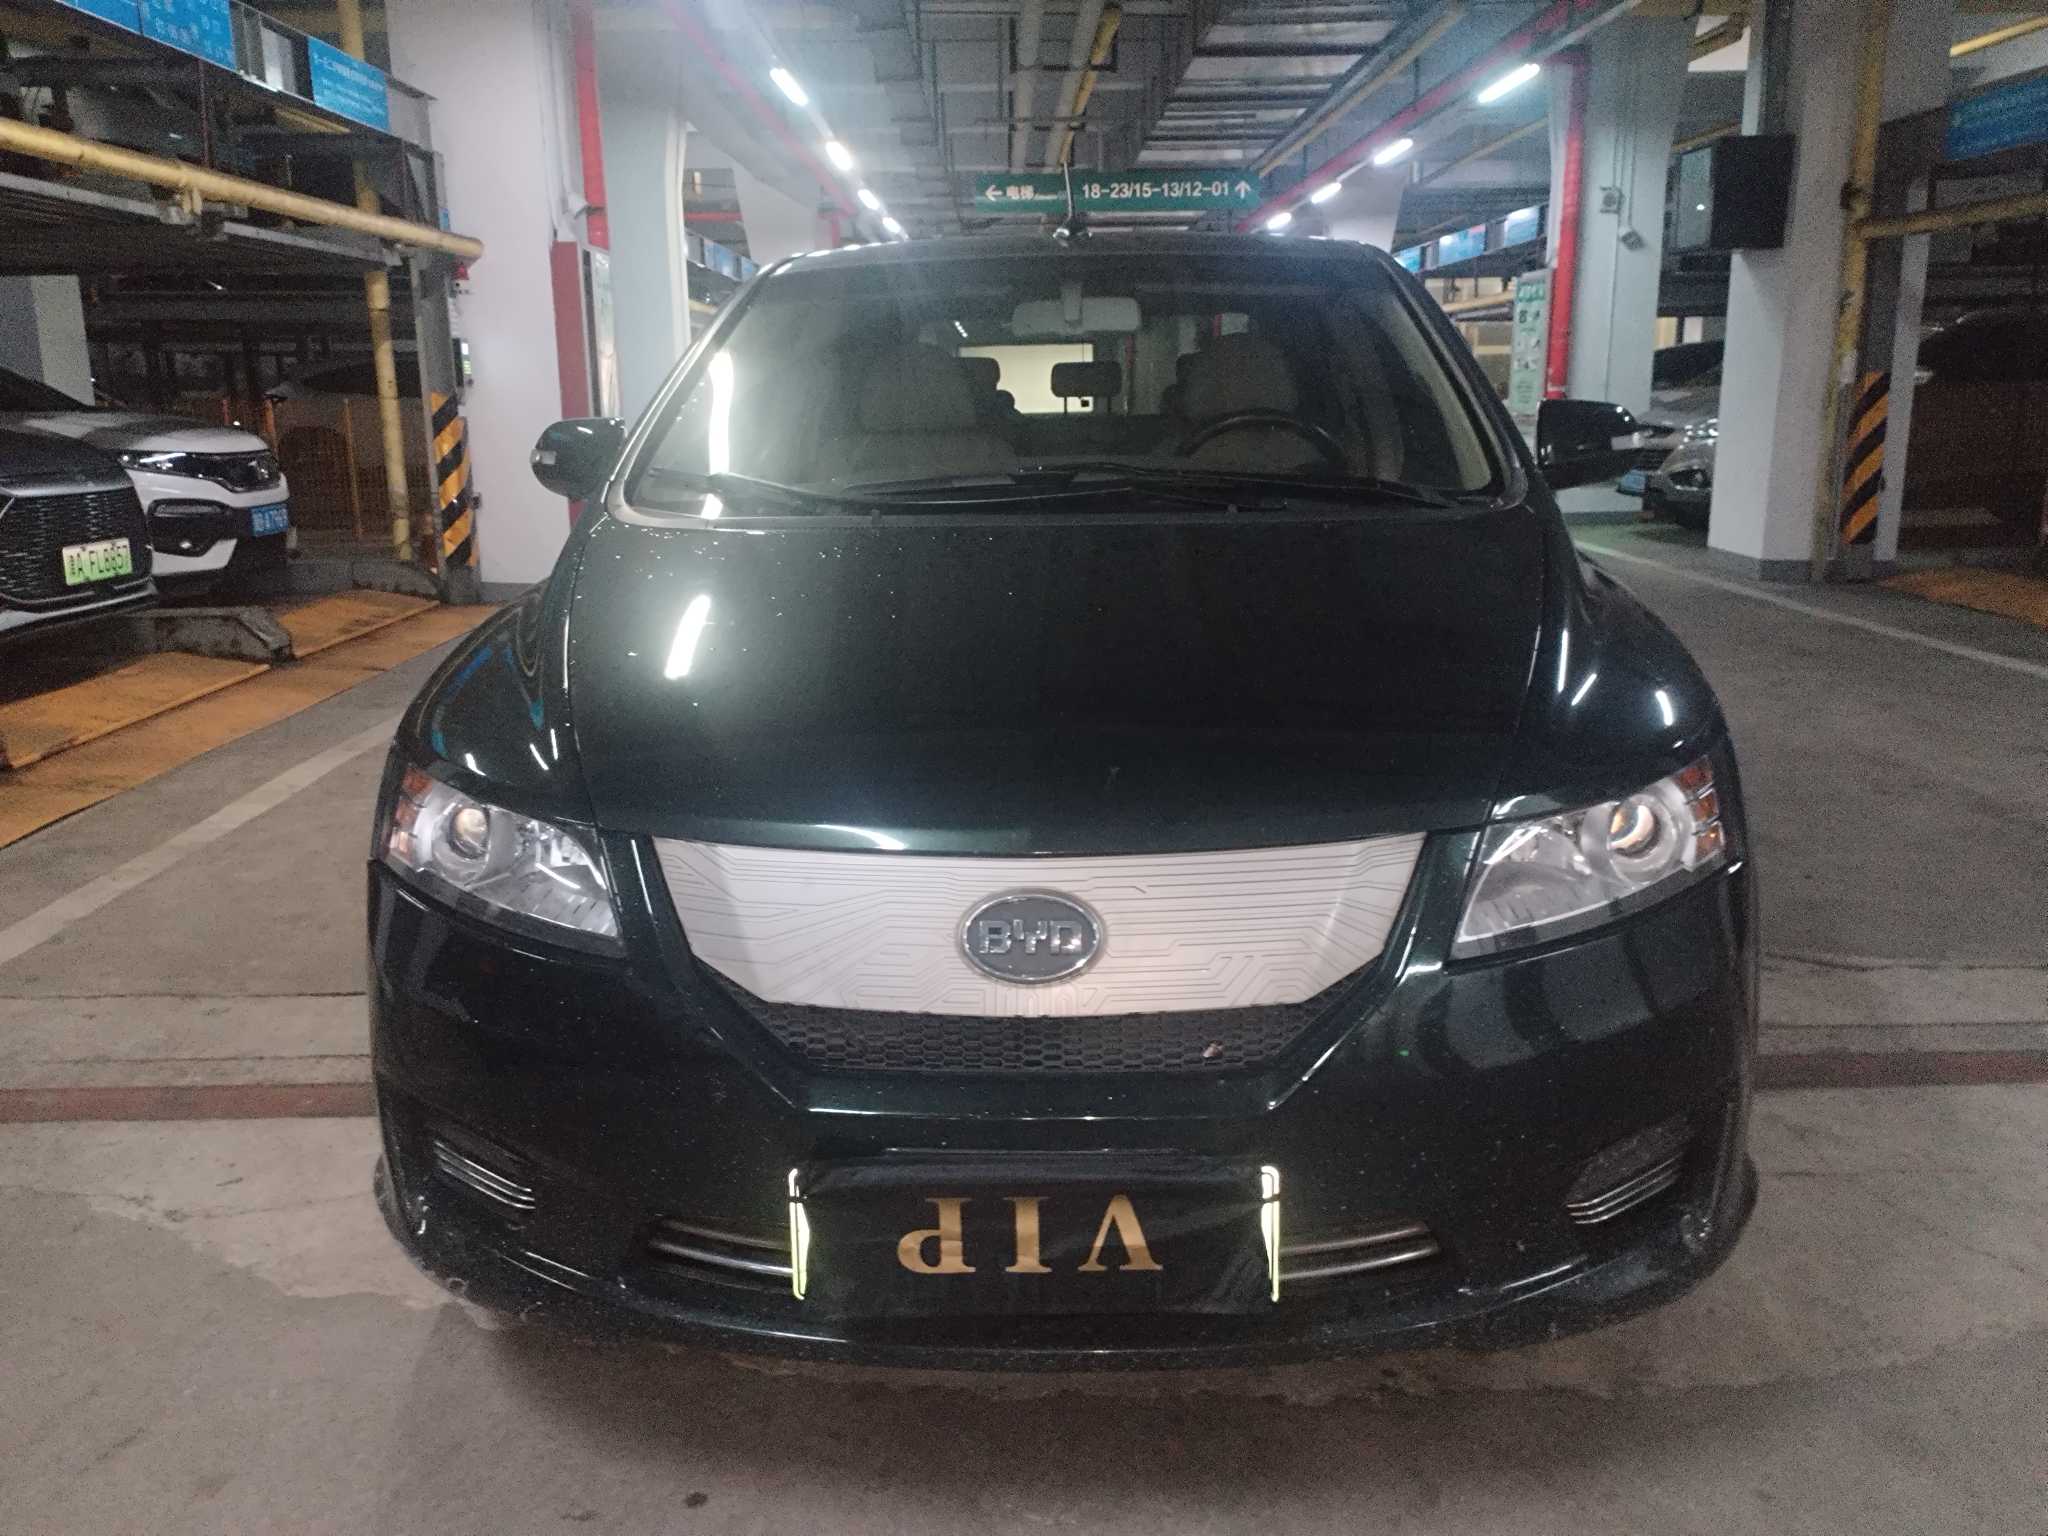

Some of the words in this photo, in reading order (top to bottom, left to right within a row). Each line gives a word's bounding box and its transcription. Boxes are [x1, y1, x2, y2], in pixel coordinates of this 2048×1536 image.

[1082, 182, 1230, 199] 18-23/15-13/12-01
[979, 919, 1082, 954] BYD
[897, 1194, 1164, 1274] VIP
